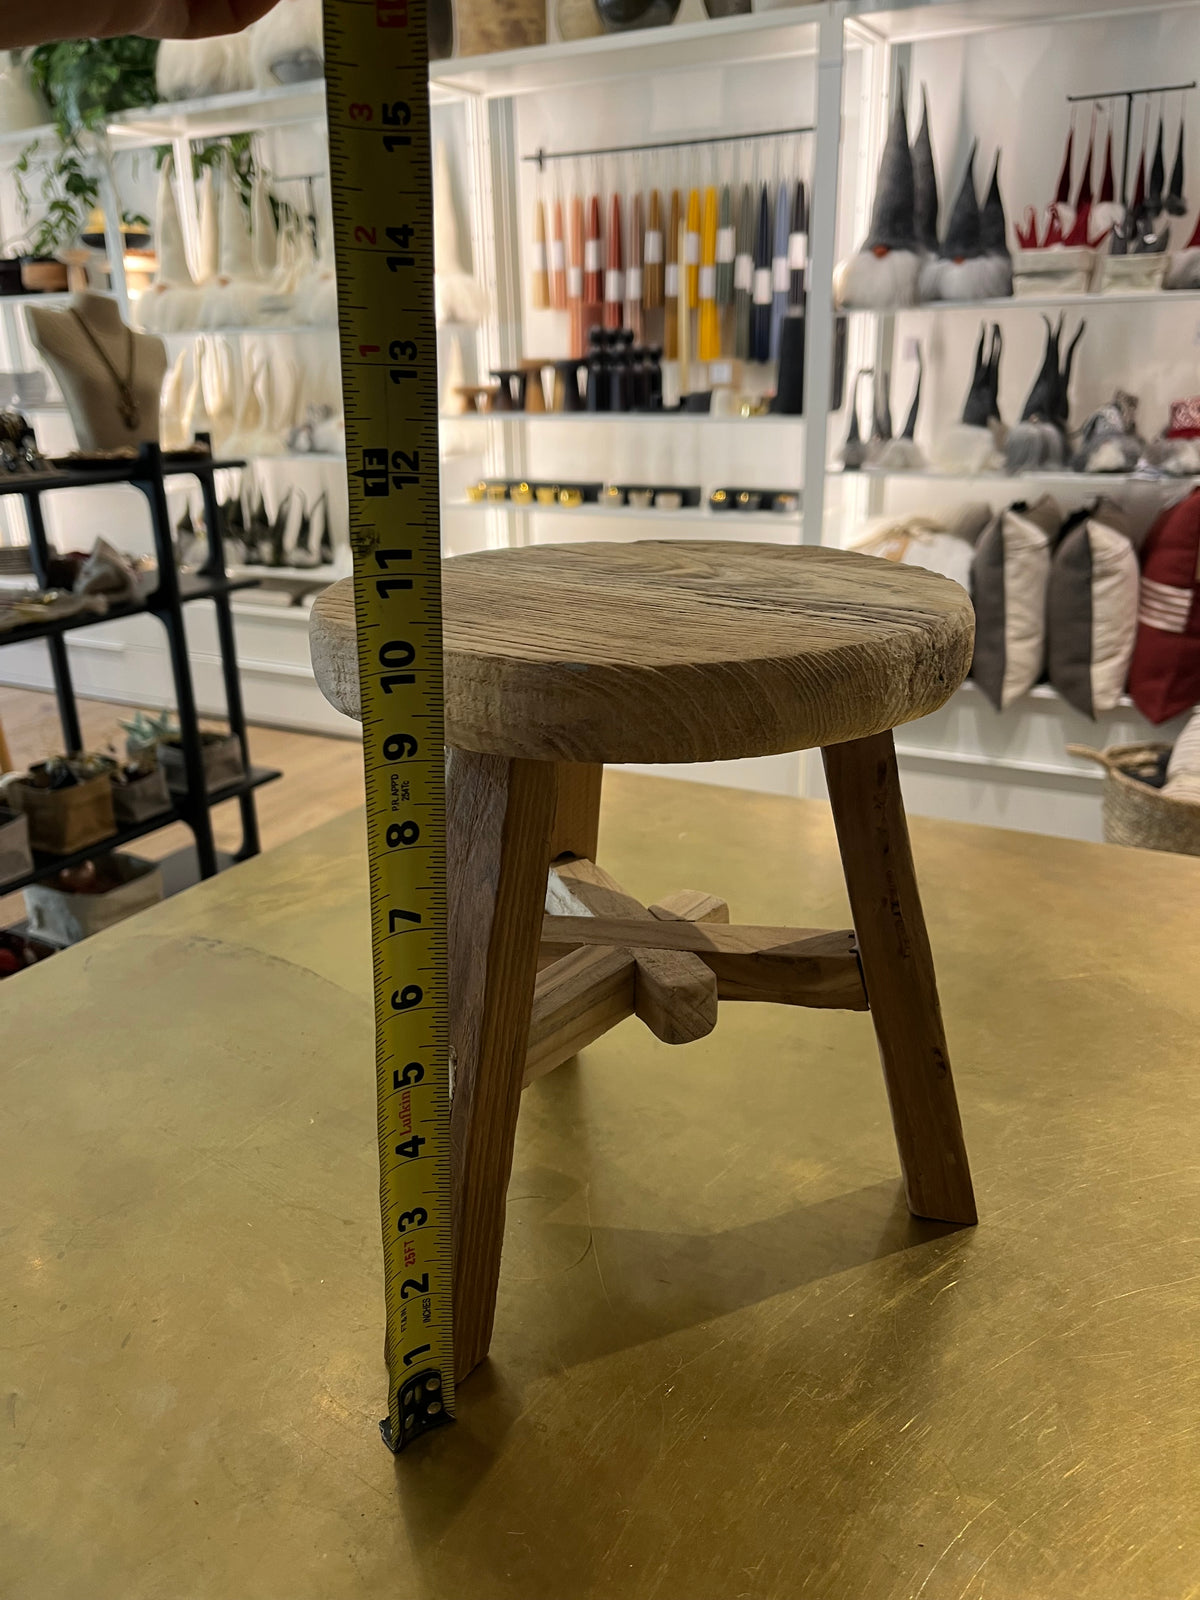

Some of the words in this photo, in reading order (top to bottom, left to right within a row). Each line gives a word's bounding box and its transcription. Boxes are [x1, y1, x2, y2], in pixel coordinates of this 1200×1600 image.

[349, 103, 373, 121] 3
[382, 102, 411, 152] 15
[354, 226, 376, 245] 2
[386, 224, 415, 272] 14
[359, 345, 380, 357] 1
[389, 340, 418, 384] 13
[365, 457, 387, 487] 1F
[391, 451, 419, 489] 12
[375, 550, 413, 599] 11
[379, 641, 415, 694] 10
[383, 733, 418, 761] 9
[386, 821, 419, 848] 8
[389, 909, 421, 933] 7
[391, 985, 423, 1010] 6
[393, 1062, 424, 1090] 5
[399, 1090, 412, 1136] Lufkin
[395, 1135, 425, 1158] 4
[398, 1207, 428, 1232] 3
[404, 1240, 416, 1267] 25FT
[401, 1273, 429, 1299] 2
[423, 1298, 431, 1323] INCHES
[403, 1344, 430, 1367] 1
